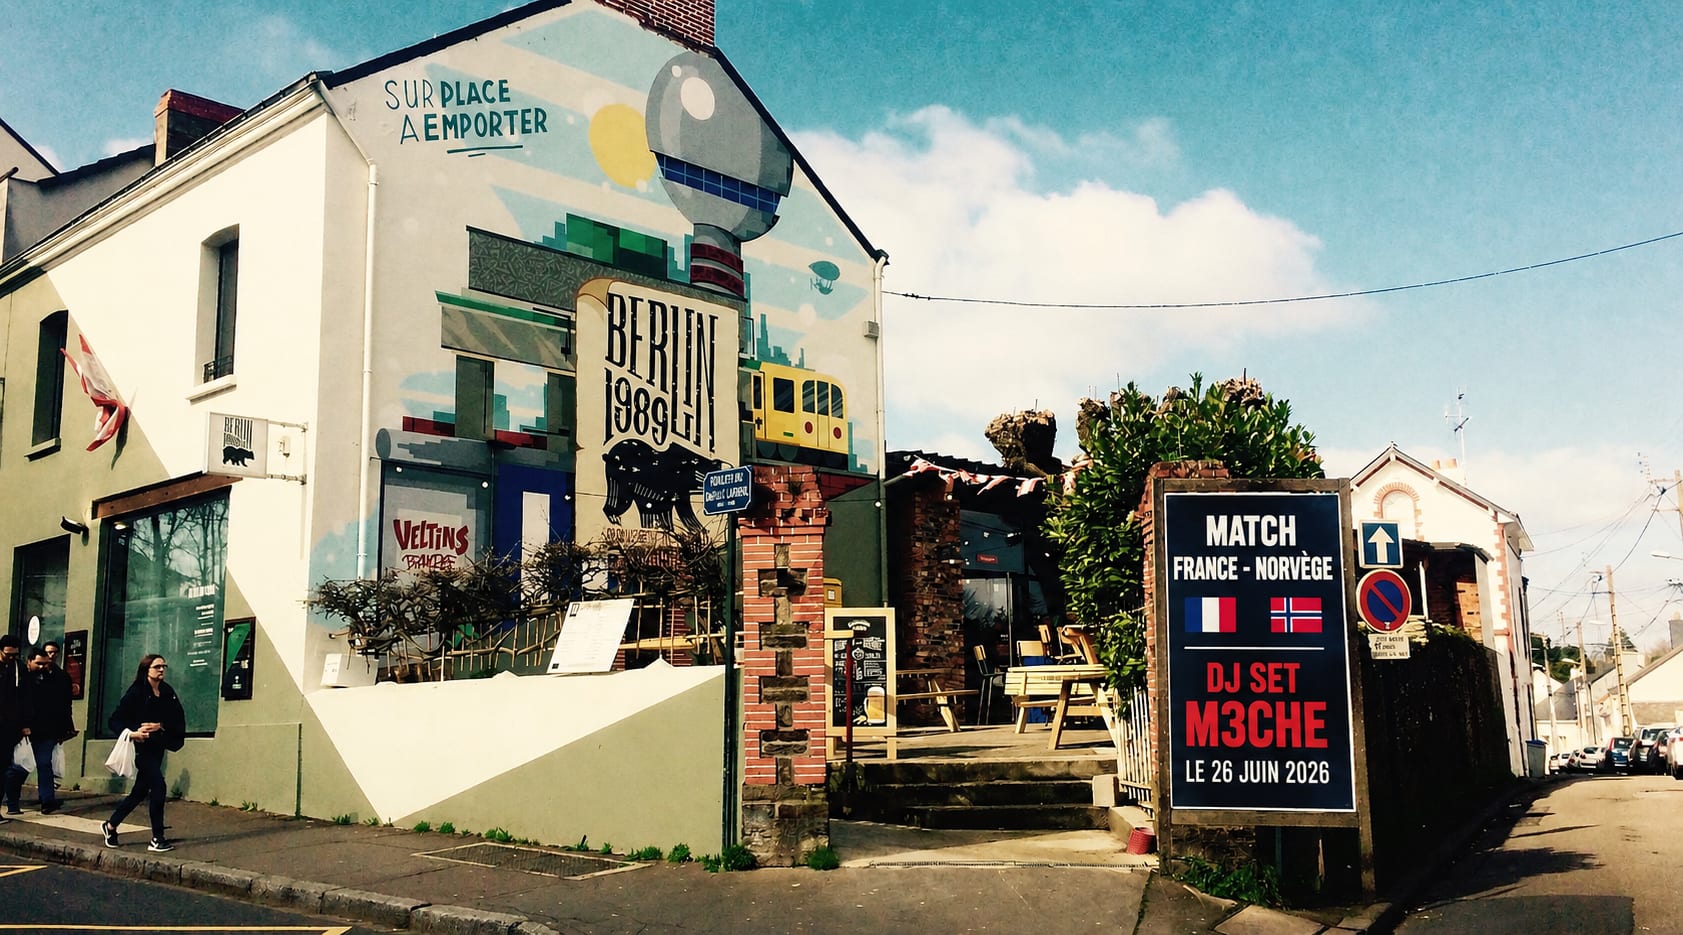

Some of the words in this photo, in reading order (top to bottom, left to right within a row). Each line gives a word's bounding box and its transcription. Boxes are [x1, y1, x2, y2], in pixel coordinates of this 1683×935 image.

[384, 79, 434, 110] SUR
[440, 79, 511, 108] PLACE
[400, 114, 419, 145] A
[423, 107, 548, 142] EMPORTER
[604, 292, 719, 453] BERLIN
[603, 367, 669, 446] 1989
[1206, 514, 1297, 547] MATCH
[1173, 556, 1239, 581] FRANCE
[1255, 550, 1334, 581] NORVÈGE
[1207, 662, 1241, 694] DJ
[1250, 662, 1300, 694] SET
[1185, 700, 1329, 748] M3CHE
[1185, 760, 1205, 783] LE
[1211, 760, 1233, 783] 26
[1239, 760, 1279, 784] JUIN
[1285, 760, 1330, 784] 2026
